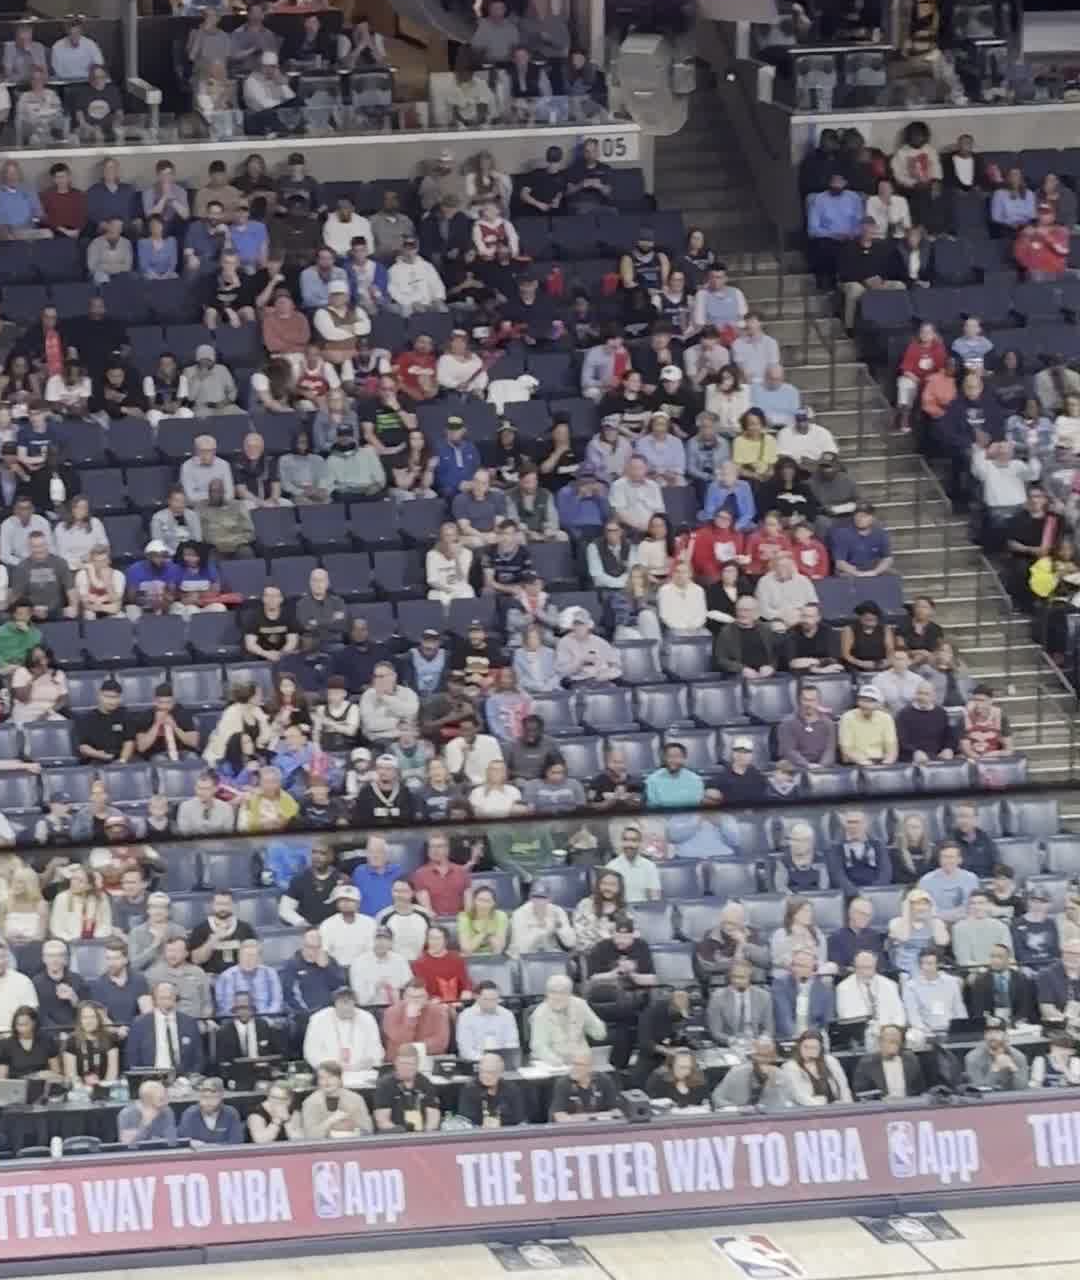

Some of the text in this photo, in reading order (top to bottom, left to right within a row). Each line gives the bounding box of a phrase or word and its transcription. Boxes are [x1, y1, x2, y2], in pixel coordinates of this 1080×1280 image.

[601, 136, 628, 158] 05
[80, 1175, 157, 1235] WAY
[163, 1172, 211, 1228] TO
[218, 1166, 293, 1225] NBA
[343, 1160, 406, 1223] App
[456, 1122, 981, 1208] THE BETTER WAY TO NBA App
